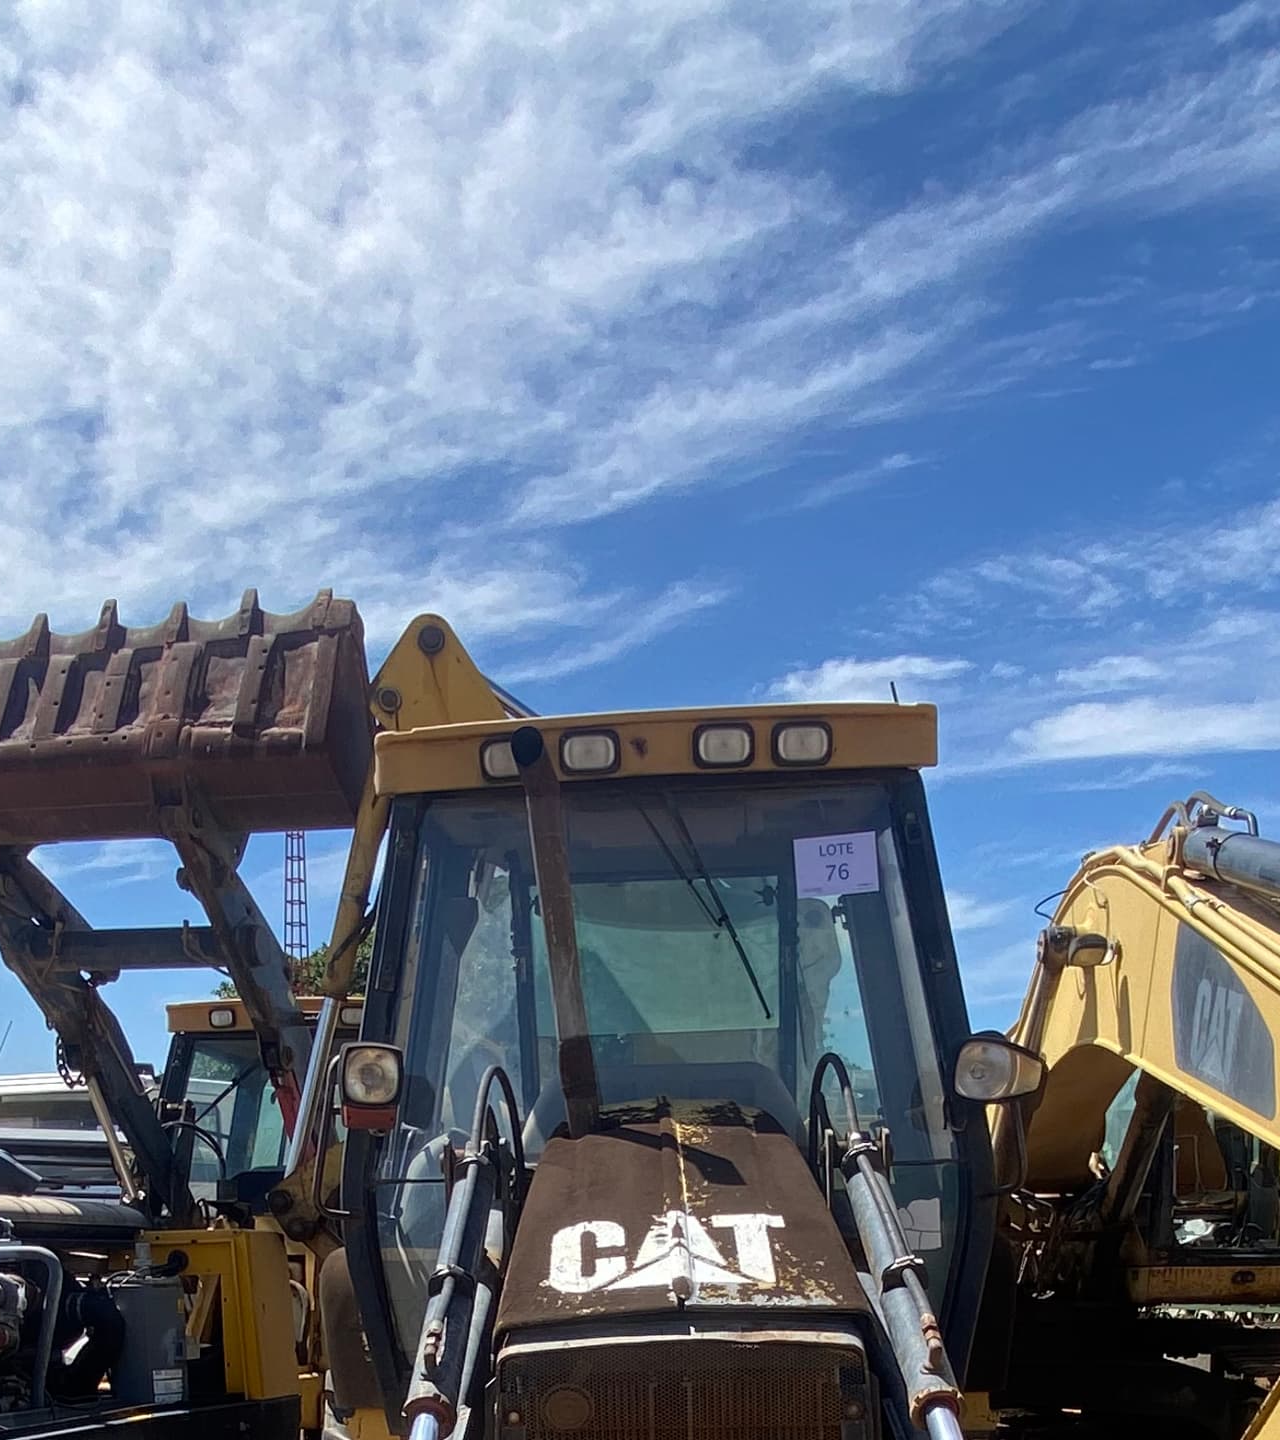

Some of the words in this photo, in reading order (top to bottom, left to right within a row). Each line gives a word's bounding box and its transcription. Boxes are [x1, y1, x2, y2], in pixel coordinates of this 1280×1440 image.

[818, 842, 855, 857] LOTE
[825, 862, 850, 882] 76
[1190, 978, 1244, 1084] CAT
[548, 1210, 786, 1294] CAT
